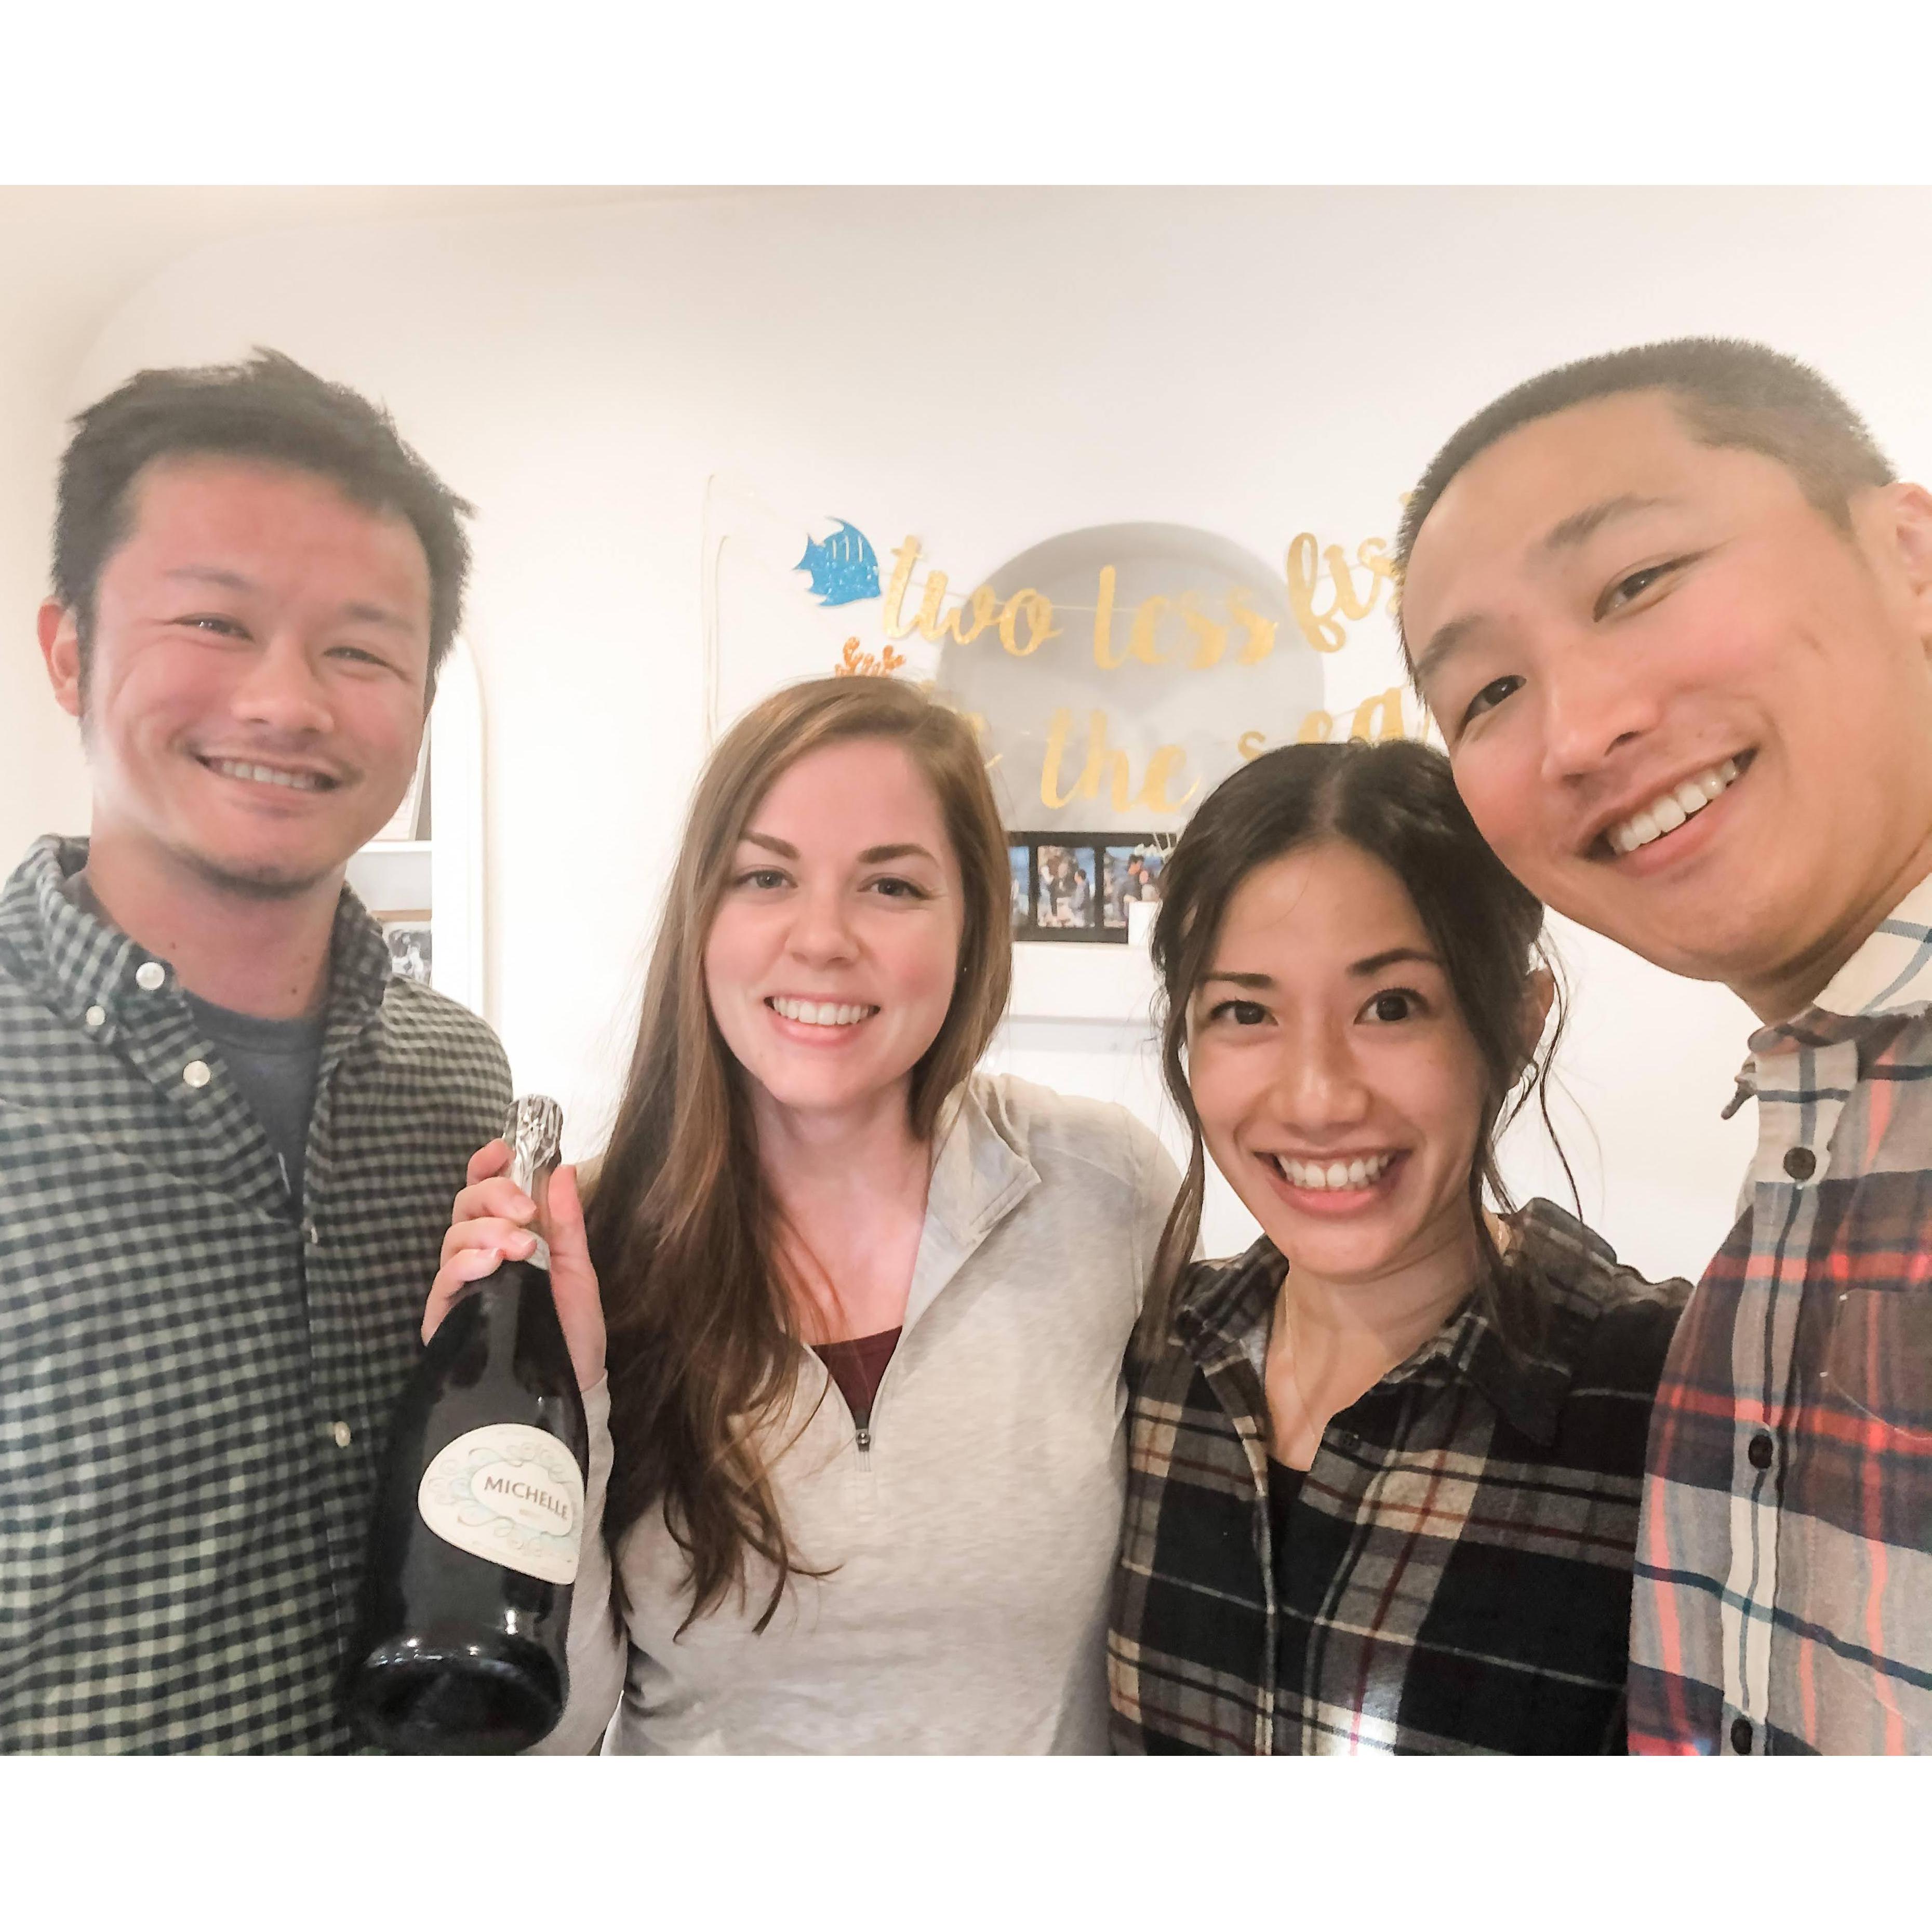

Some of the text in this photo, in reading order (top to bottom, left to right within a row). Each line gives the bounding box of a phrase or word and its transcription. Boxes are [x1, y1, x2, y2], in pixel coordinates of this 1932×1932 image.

[884, 491, 1411, 670] two less fis
[1041, 708, 1202, 814] the
[484, 1475, 568, 1522] MICHELLE
